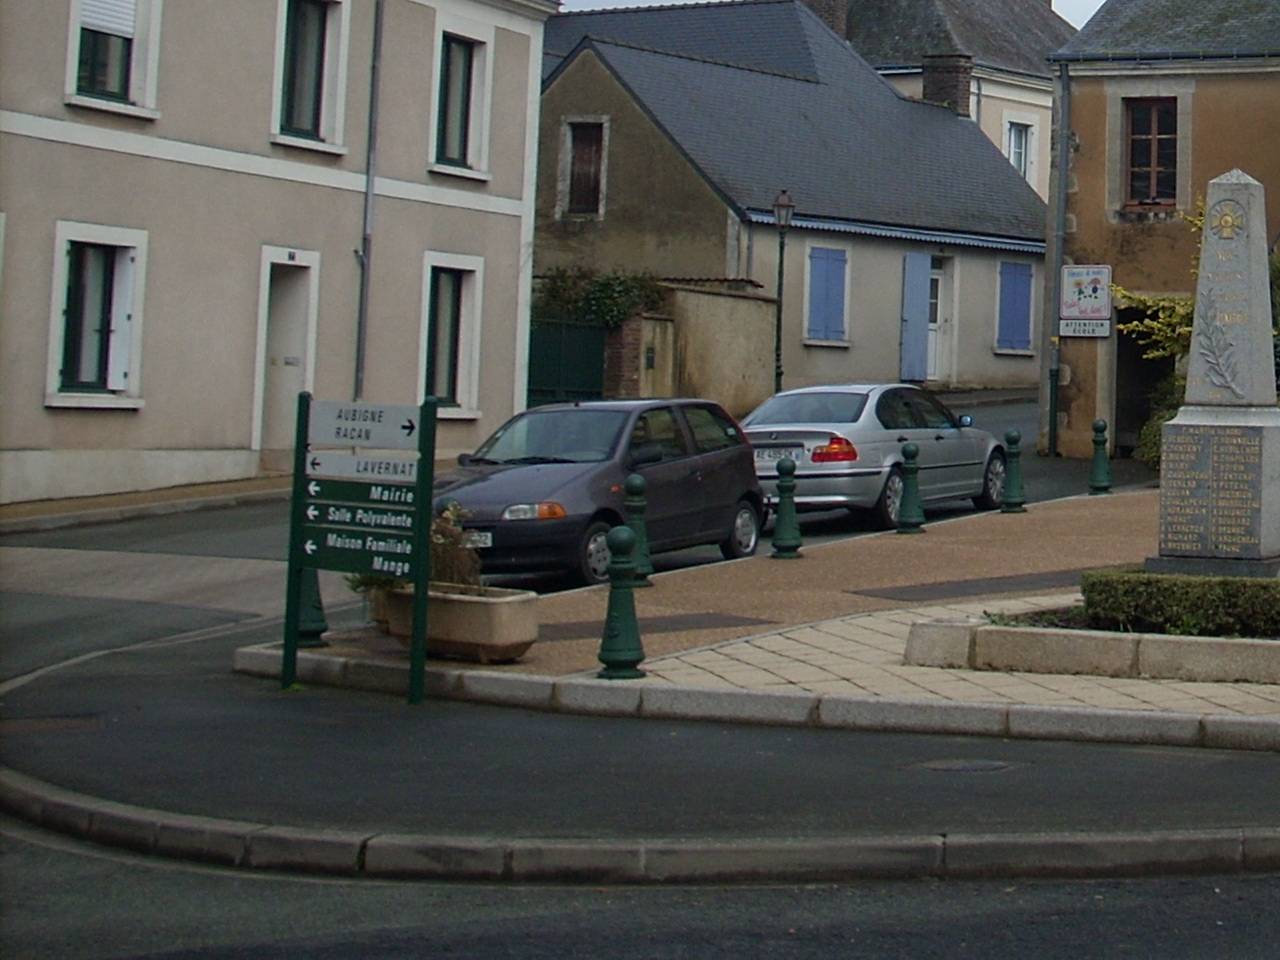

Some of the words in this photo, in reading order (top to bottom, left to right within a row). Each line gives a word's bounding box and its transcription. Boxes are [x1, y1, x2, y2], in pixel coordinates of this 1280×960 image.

[335, 426, 371, 441] RACAN
[356, 461, 415, 477] LAVERNAT
[369, 485, 414, 503] Mairie
[327, 506, 352, 522] Salle
[355, 509, 413, 528] Polyvalente
[326, 533, 363, 550] Maison
[365, 536, 412, 554] Familiale
